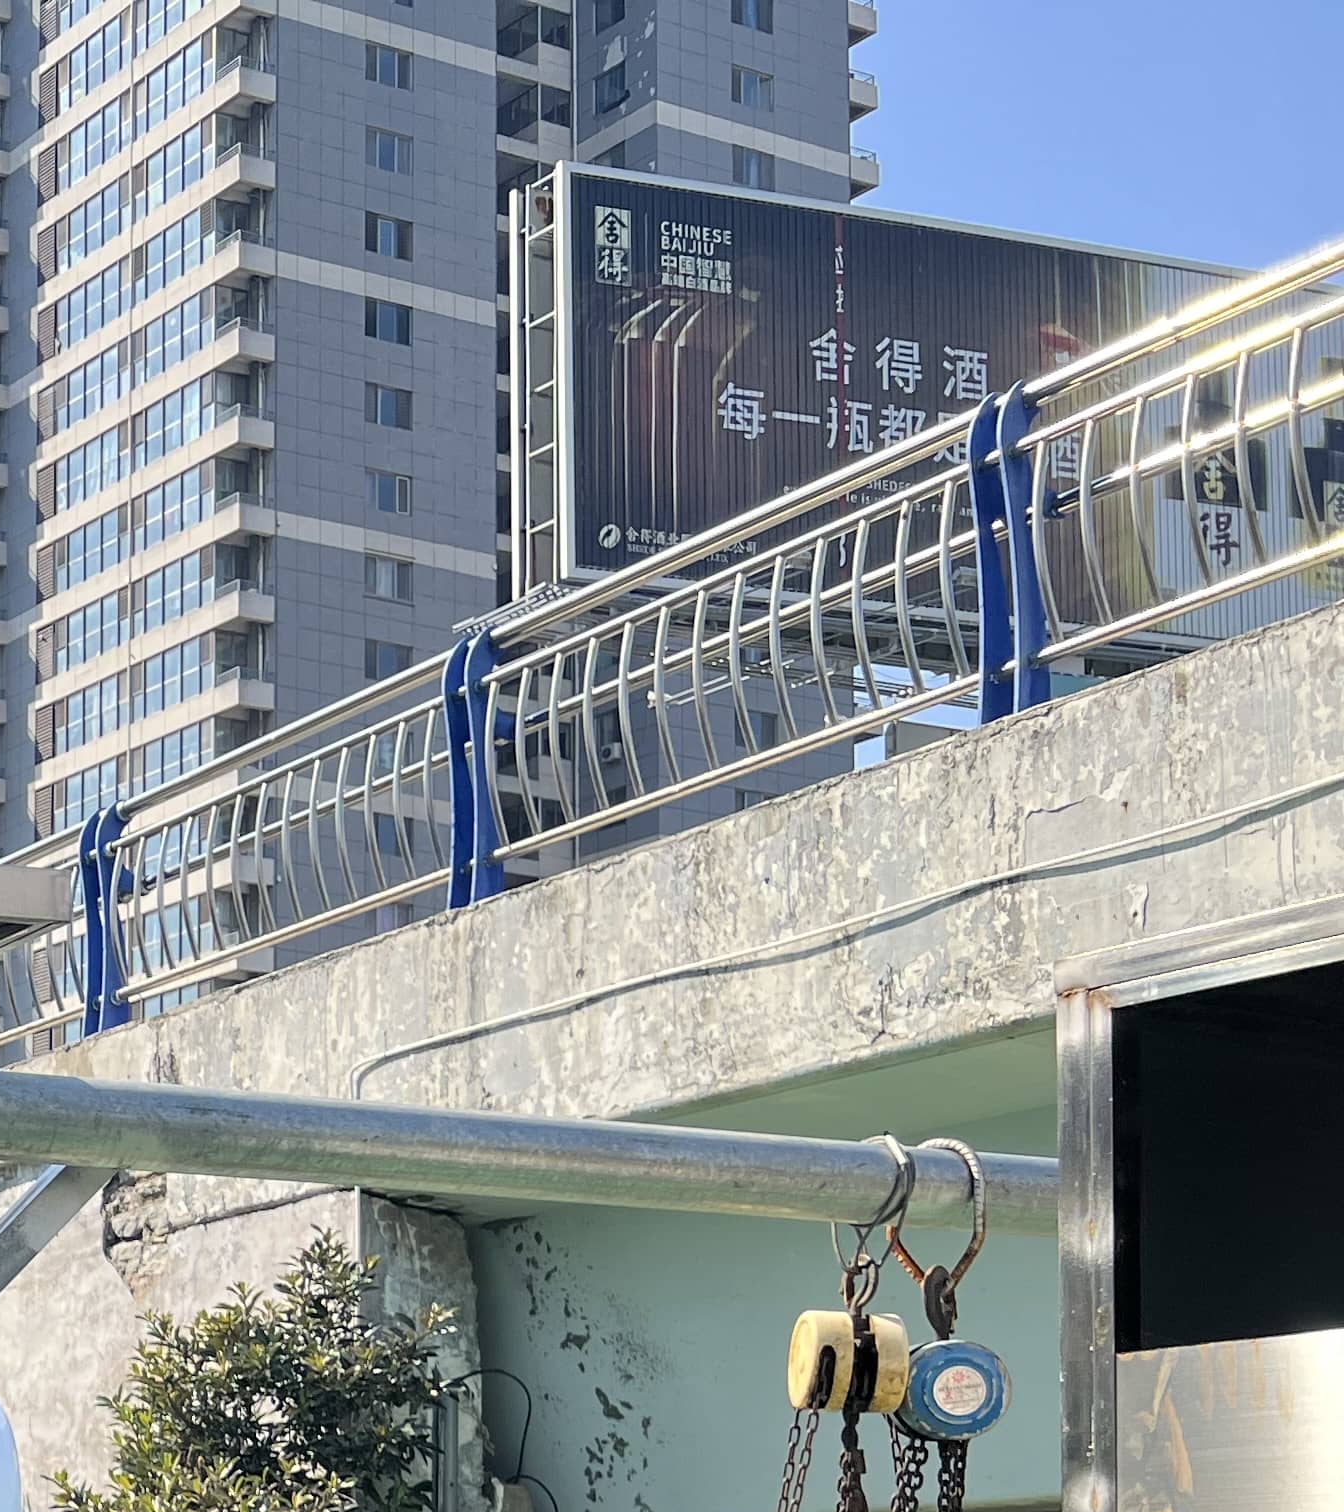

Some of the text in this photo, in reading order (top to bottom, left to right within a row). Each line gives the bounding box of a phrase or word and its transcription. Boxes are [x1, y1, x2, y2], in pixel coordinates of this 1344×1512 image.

[660, 221, 732, 245] CHINESE
[660, 235, 714, 256] BAIJIU
[809, 327, 989, 400] 舍得酒
